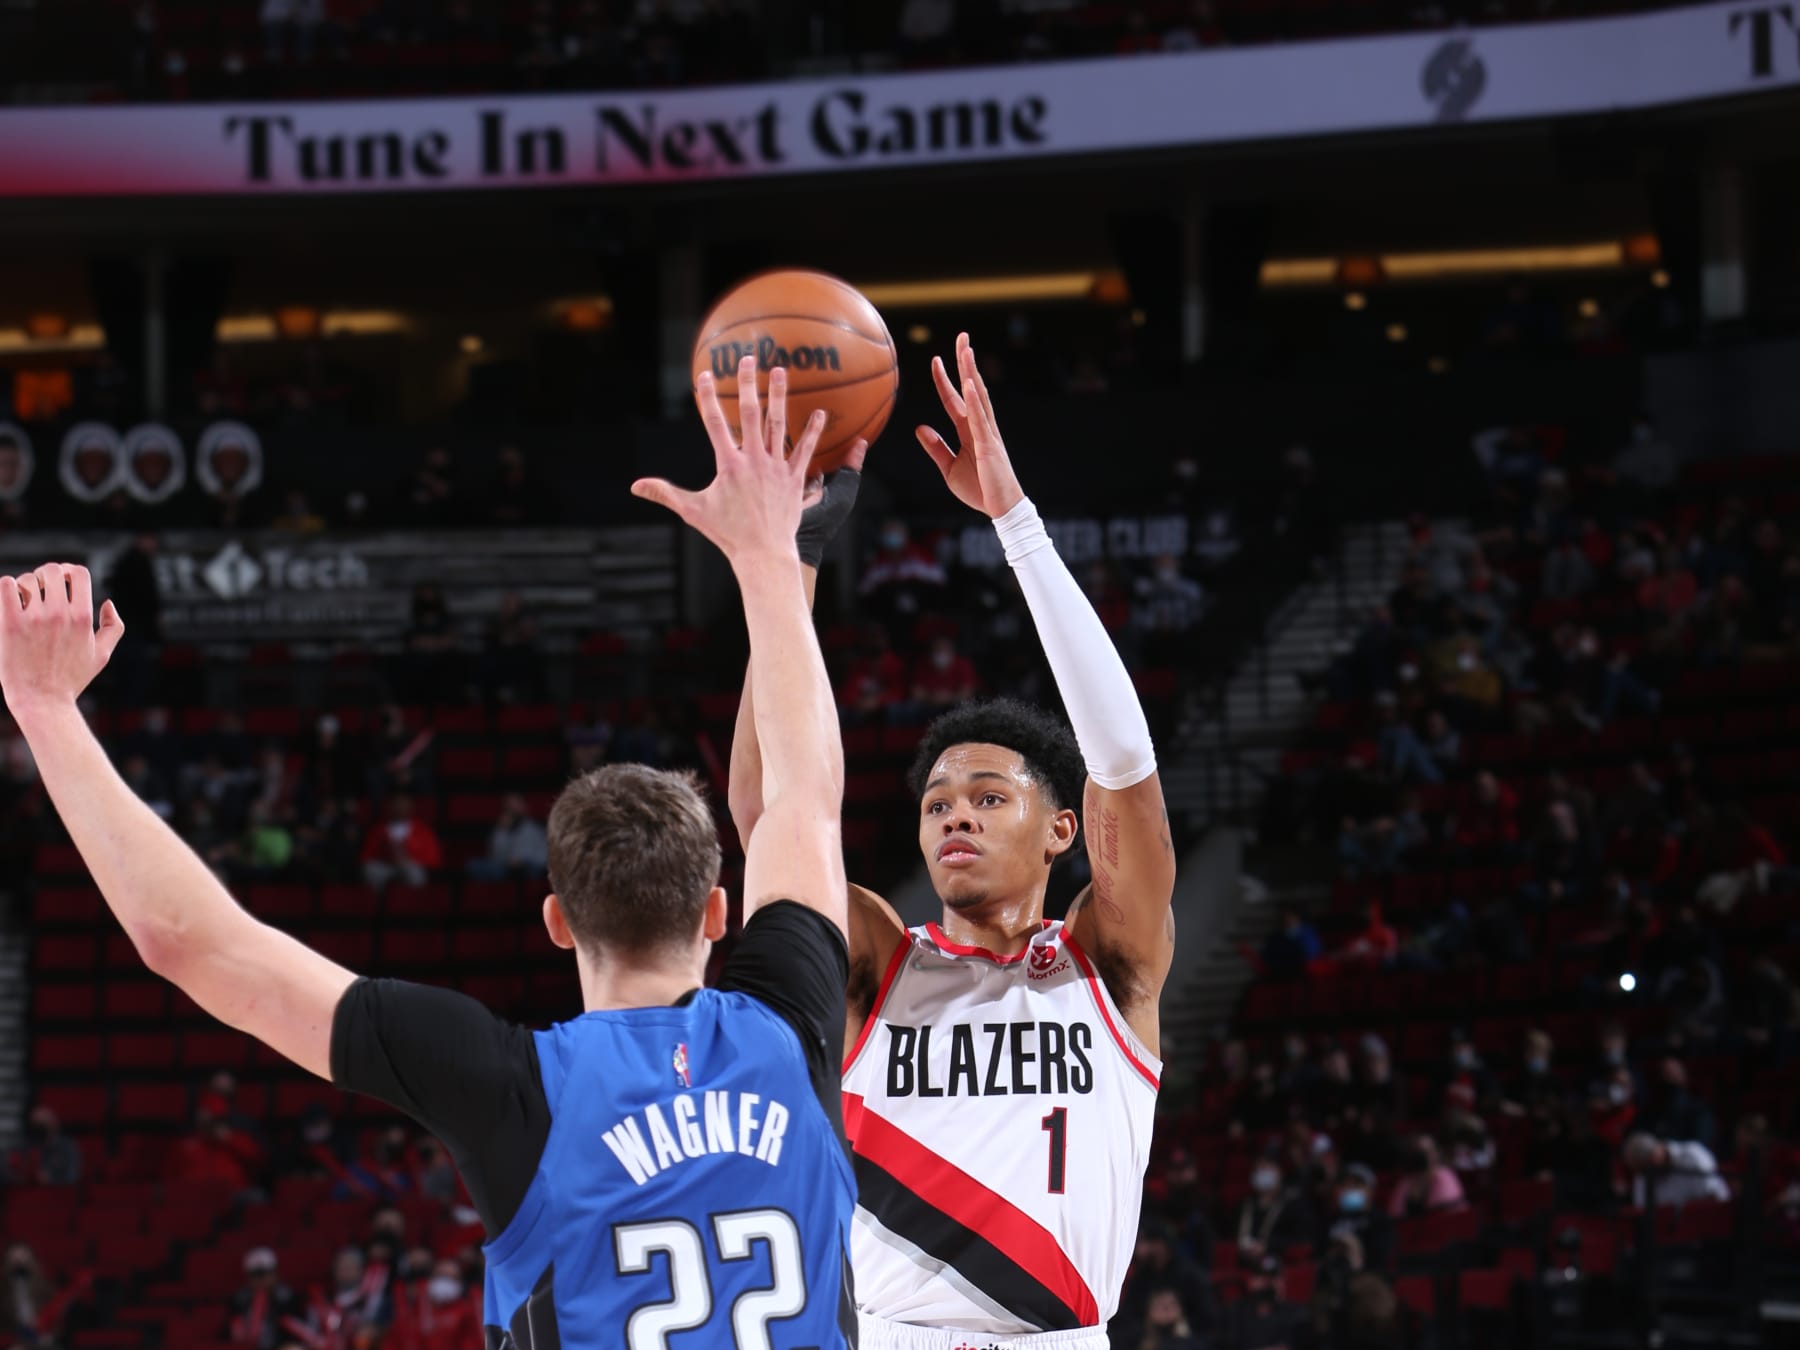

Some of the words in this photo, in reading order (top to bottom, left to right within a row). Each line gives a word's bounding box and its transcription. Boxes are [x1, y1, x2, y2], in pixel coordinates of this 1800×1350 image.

[1727, 3, 1800, 79] T
[224, 114, 449, 182] Tune
[477, 108, 567, 176] In
[594, 101, 785, 174] Next
[809, 87, 1048, 161] Game
[265, 549, 370, 590] Tech
[885, 1021, 1094, 1098] BLAZERS
[601, 1090, 790, 1187] WAGNER
[1041, 1106, 1068, 1195] 1
